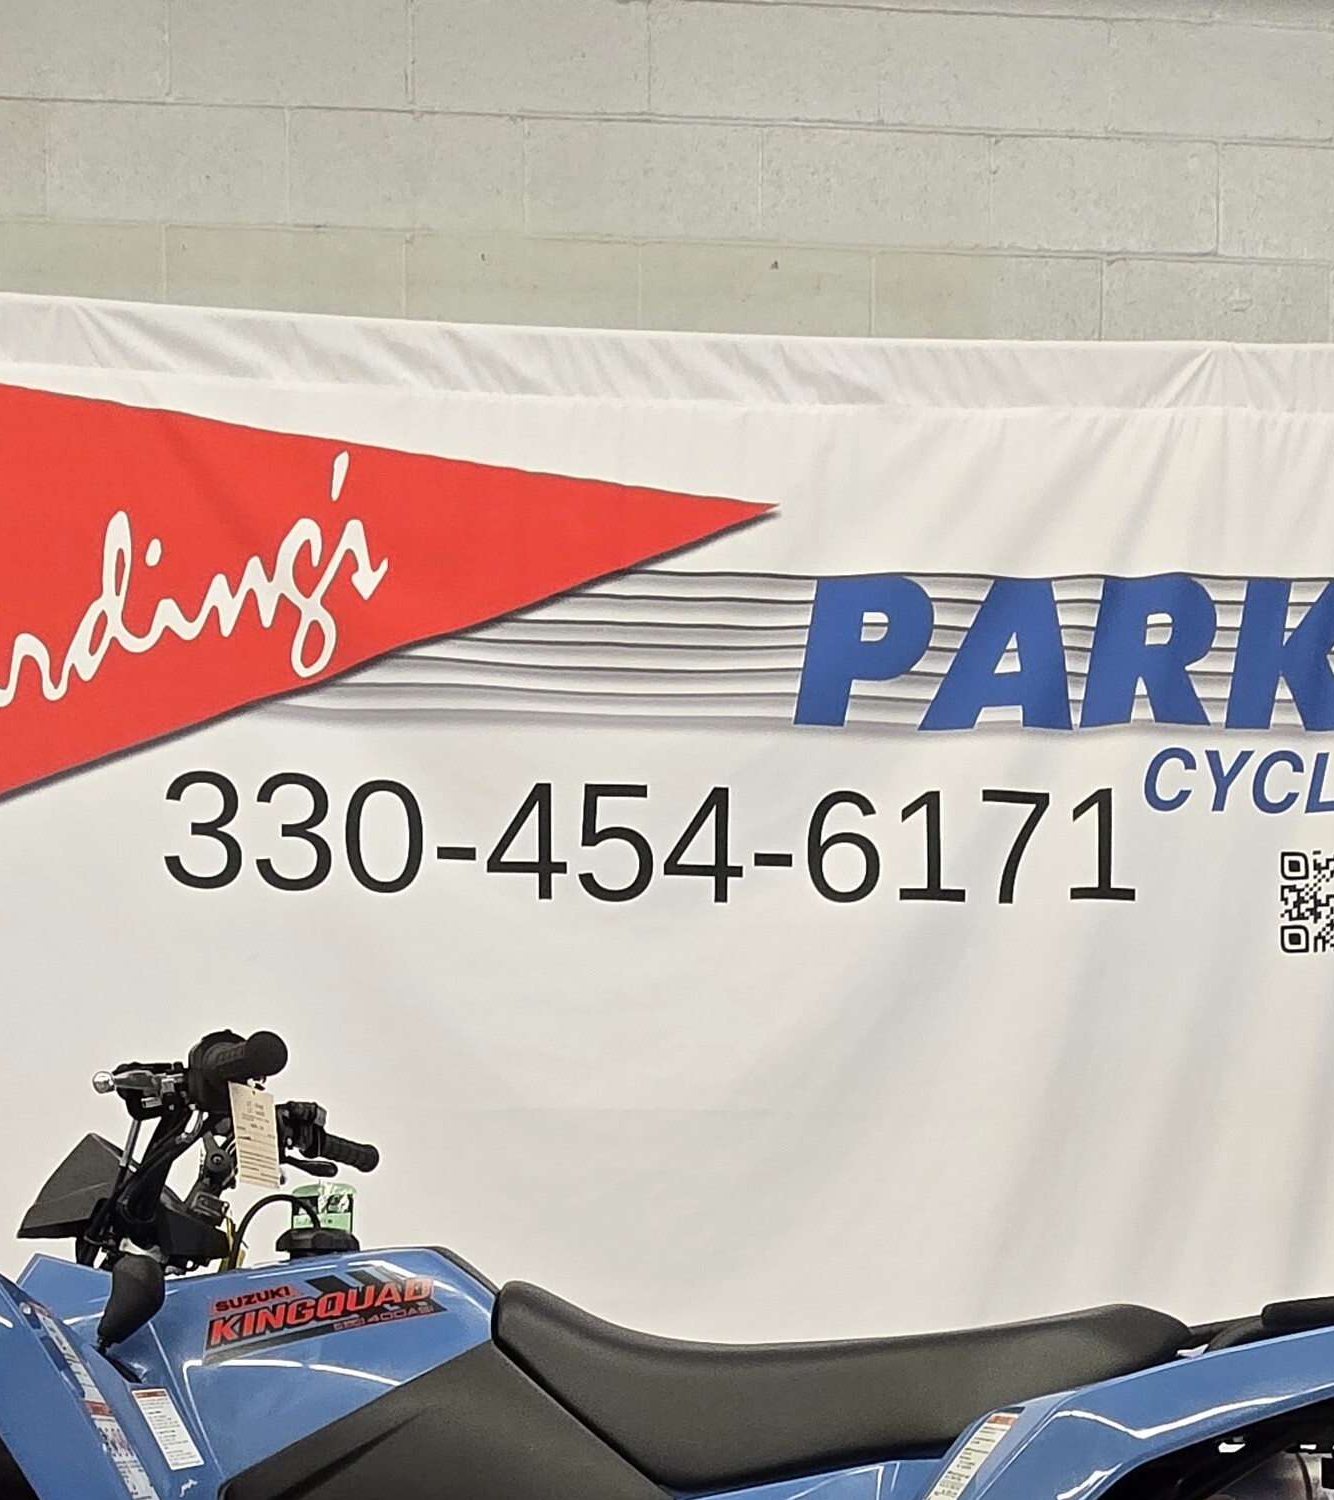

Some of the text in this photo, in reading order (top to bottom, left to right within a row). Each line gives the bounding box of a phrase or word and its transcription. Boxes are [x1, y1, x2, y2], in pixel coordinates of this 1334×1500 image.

[164, 770, 1136, 904] 330-454-6171
[209, 1275, 435, 1346] KINGQUAD
[215, 1285, 292, 1312] SUZUKI
